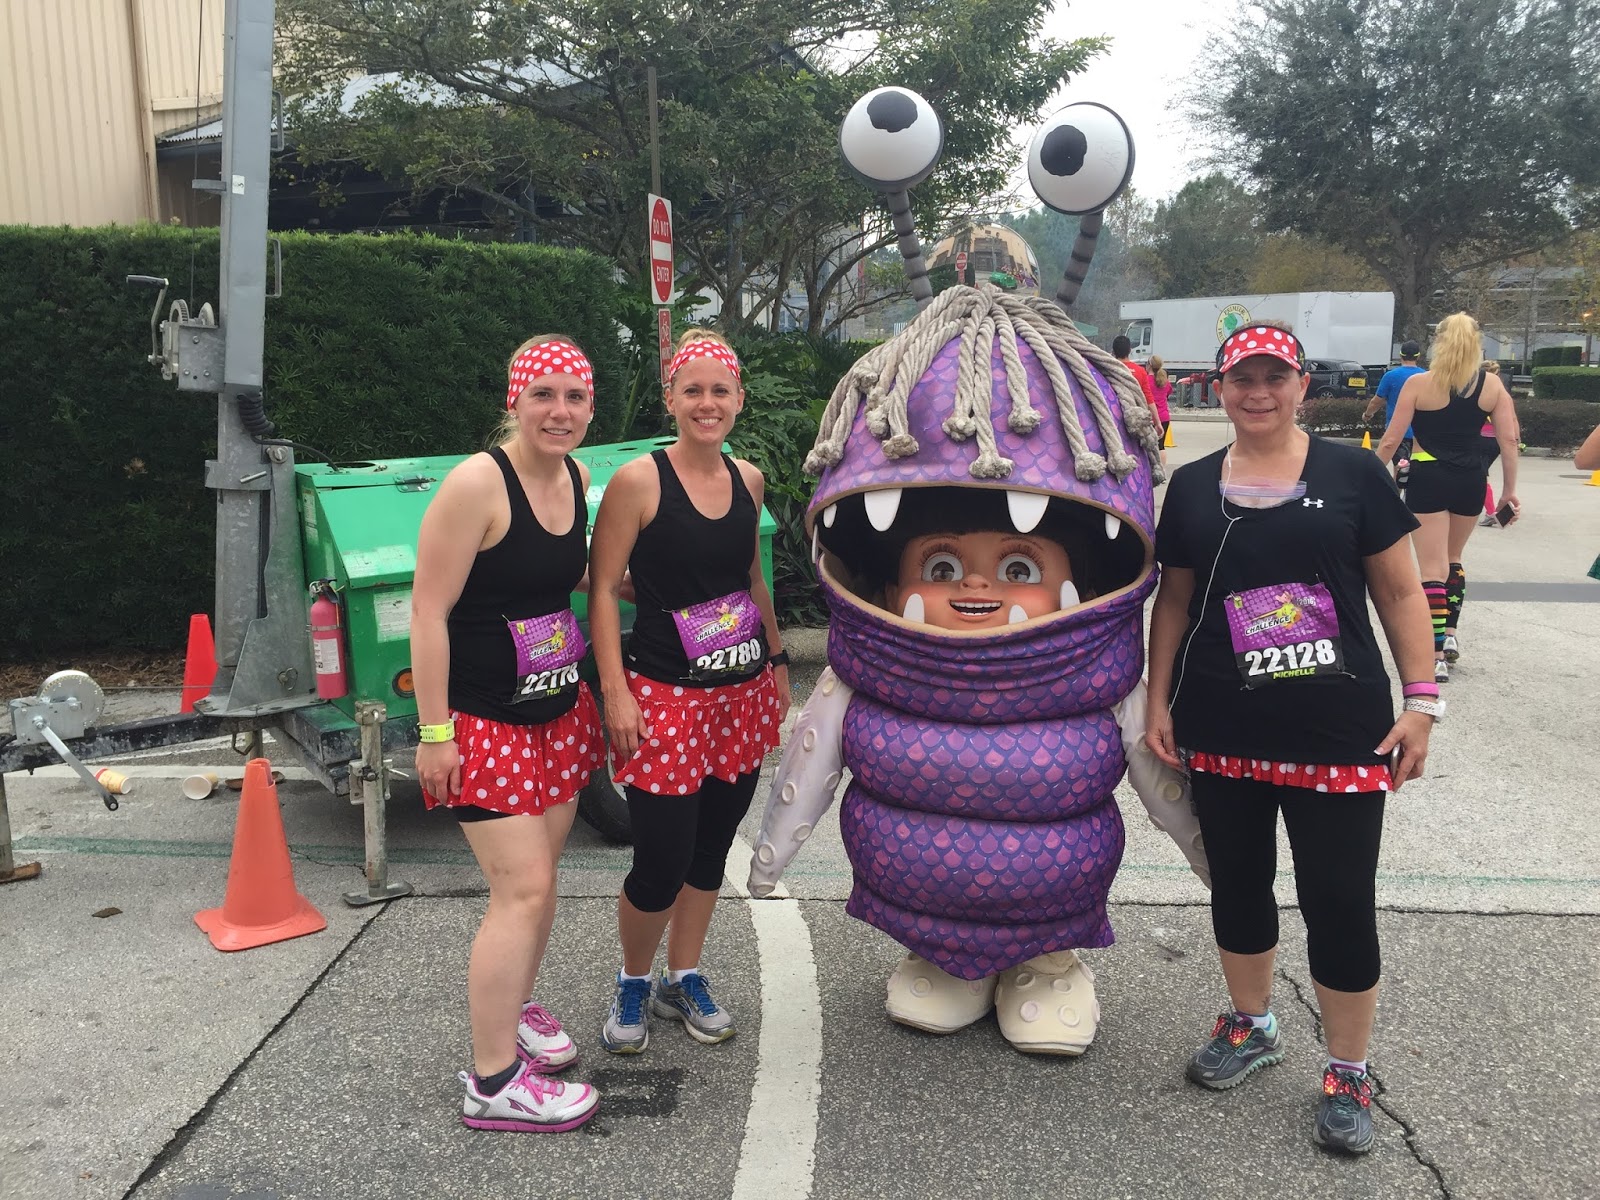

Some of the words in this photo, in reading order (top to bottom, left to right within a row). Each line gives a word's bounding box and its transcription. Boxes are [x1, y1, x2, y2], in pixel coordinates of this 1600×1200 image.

[653, 218, 660, 235] DO
[660, 220, 669, 237] NOT
[656, 265, 670, 282] ENTER
[1245, 615, 1290, 635] CHALLENGE
[697, 639, 761, 670] 22780
[1244, 639, 1336, 676] 22128
[521, 662, 579, 695] 22778
[1273, 667, 1316, 680] MICHELLE
